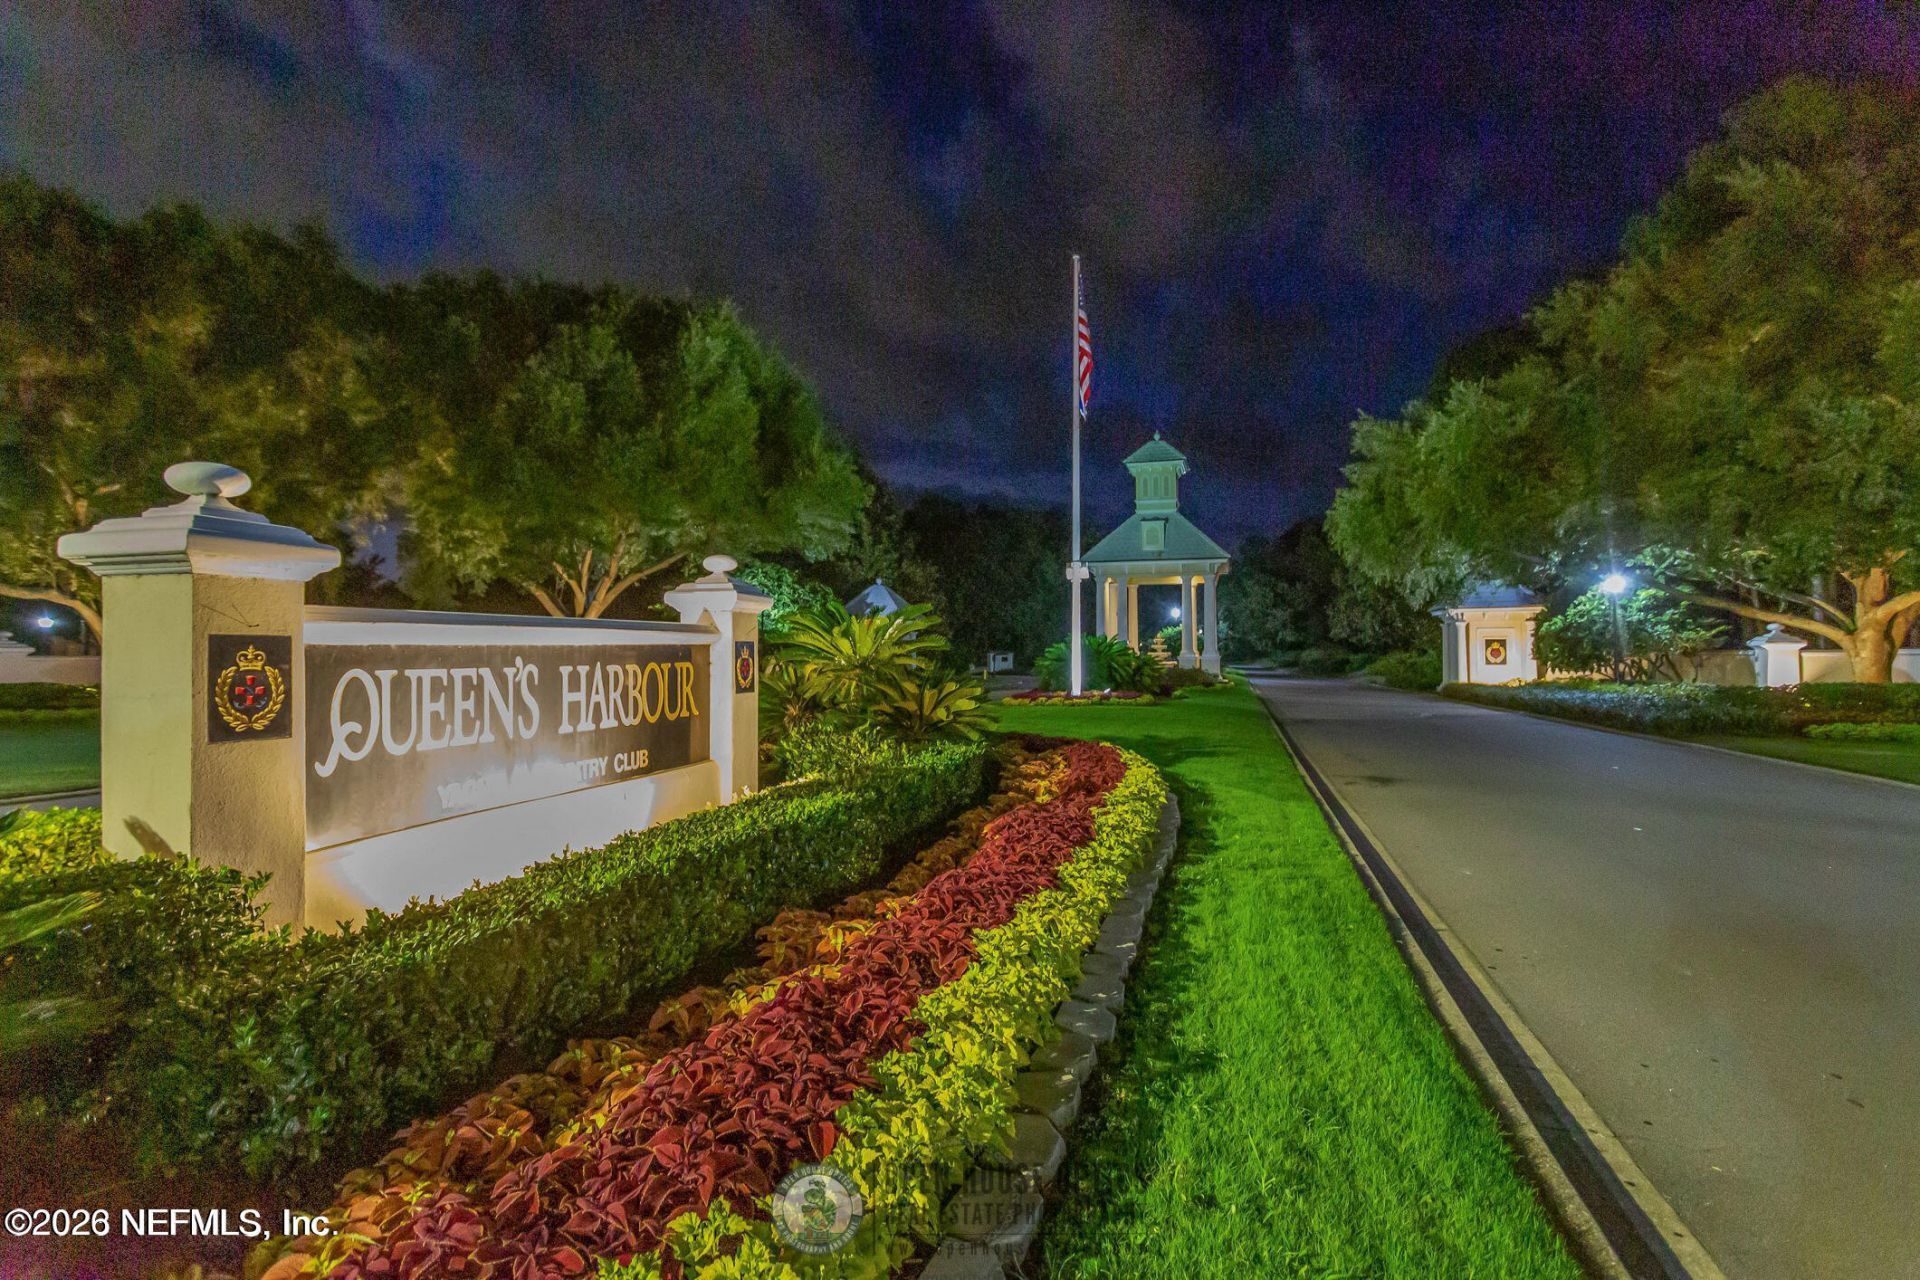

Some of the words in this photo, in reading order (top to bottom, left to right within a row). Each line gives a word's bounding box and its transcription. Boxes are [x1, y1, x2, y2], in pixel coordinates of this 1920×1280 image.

[314, 656, 540, 778] QUEEN'S
[558, 661, 699, 735] HARBOUR
[614, 749, 649, 773] CLUB
